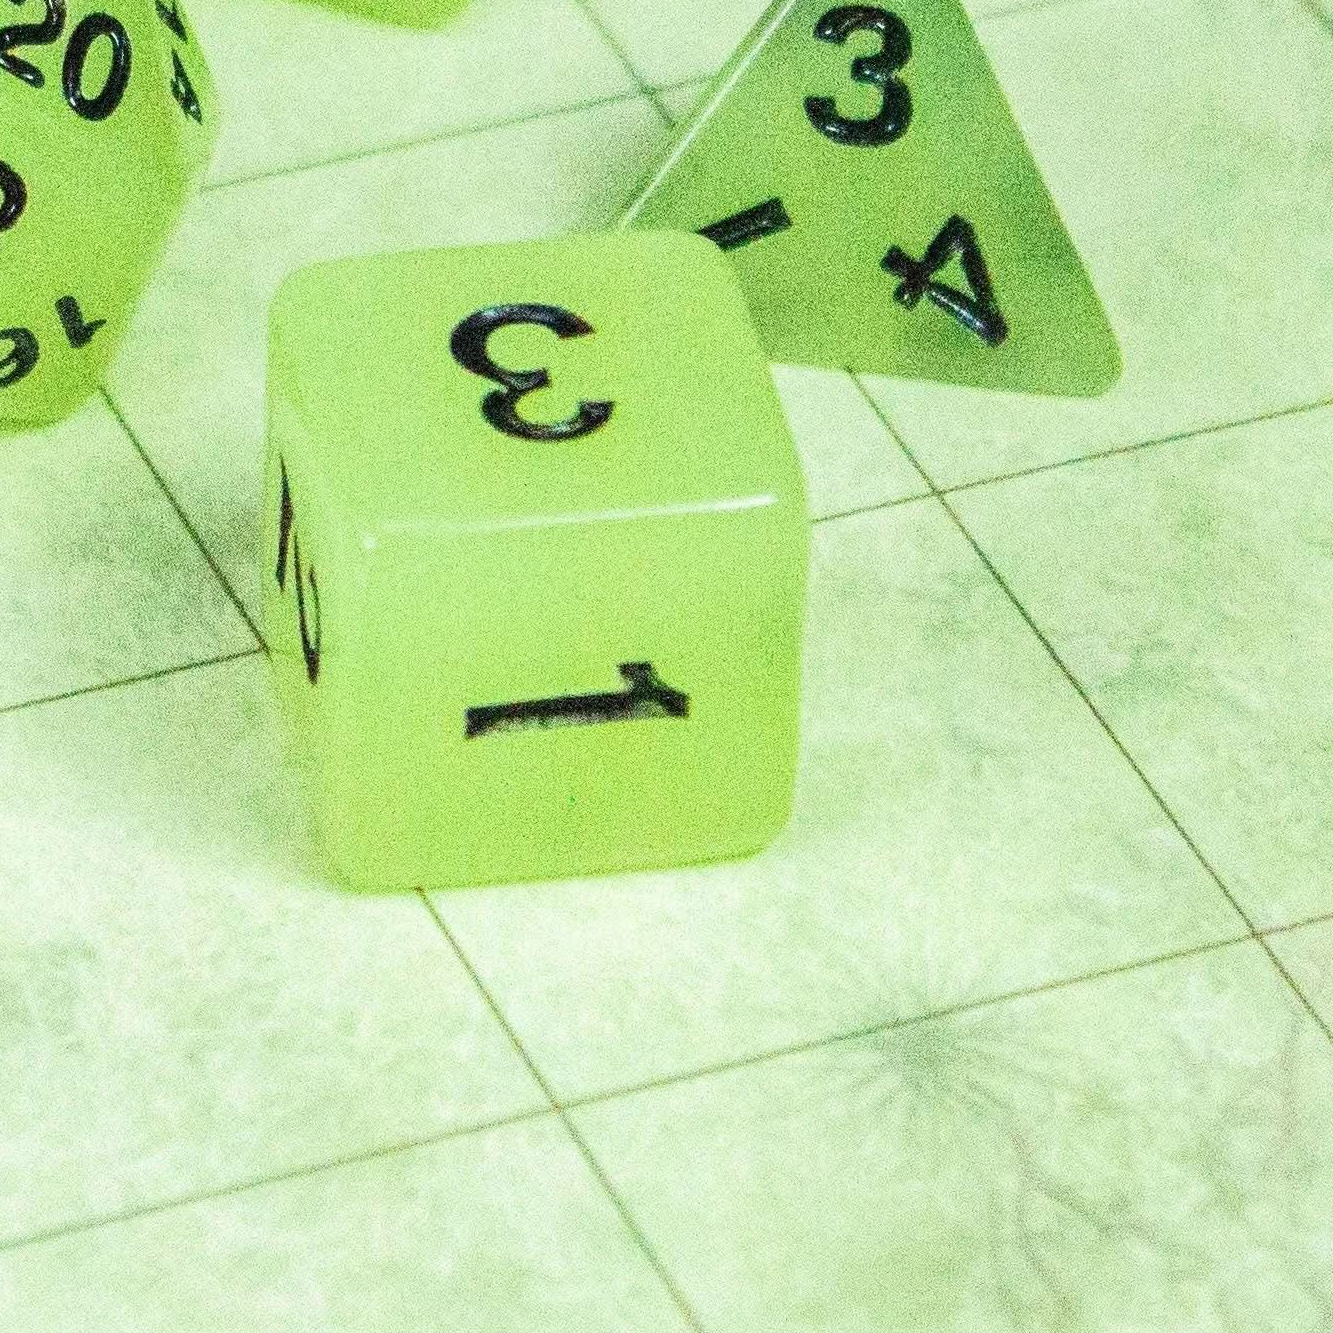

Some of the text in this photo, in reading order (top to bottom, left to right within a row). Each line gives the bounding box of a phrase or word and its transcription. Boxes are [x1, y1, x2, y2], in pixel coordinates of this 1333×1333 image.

[804, 4, 912, 147] 3
[881, 215, 1008, 347] 4
[449, 304, 614, 442] 3
[465, 662, 688, 738] 1
